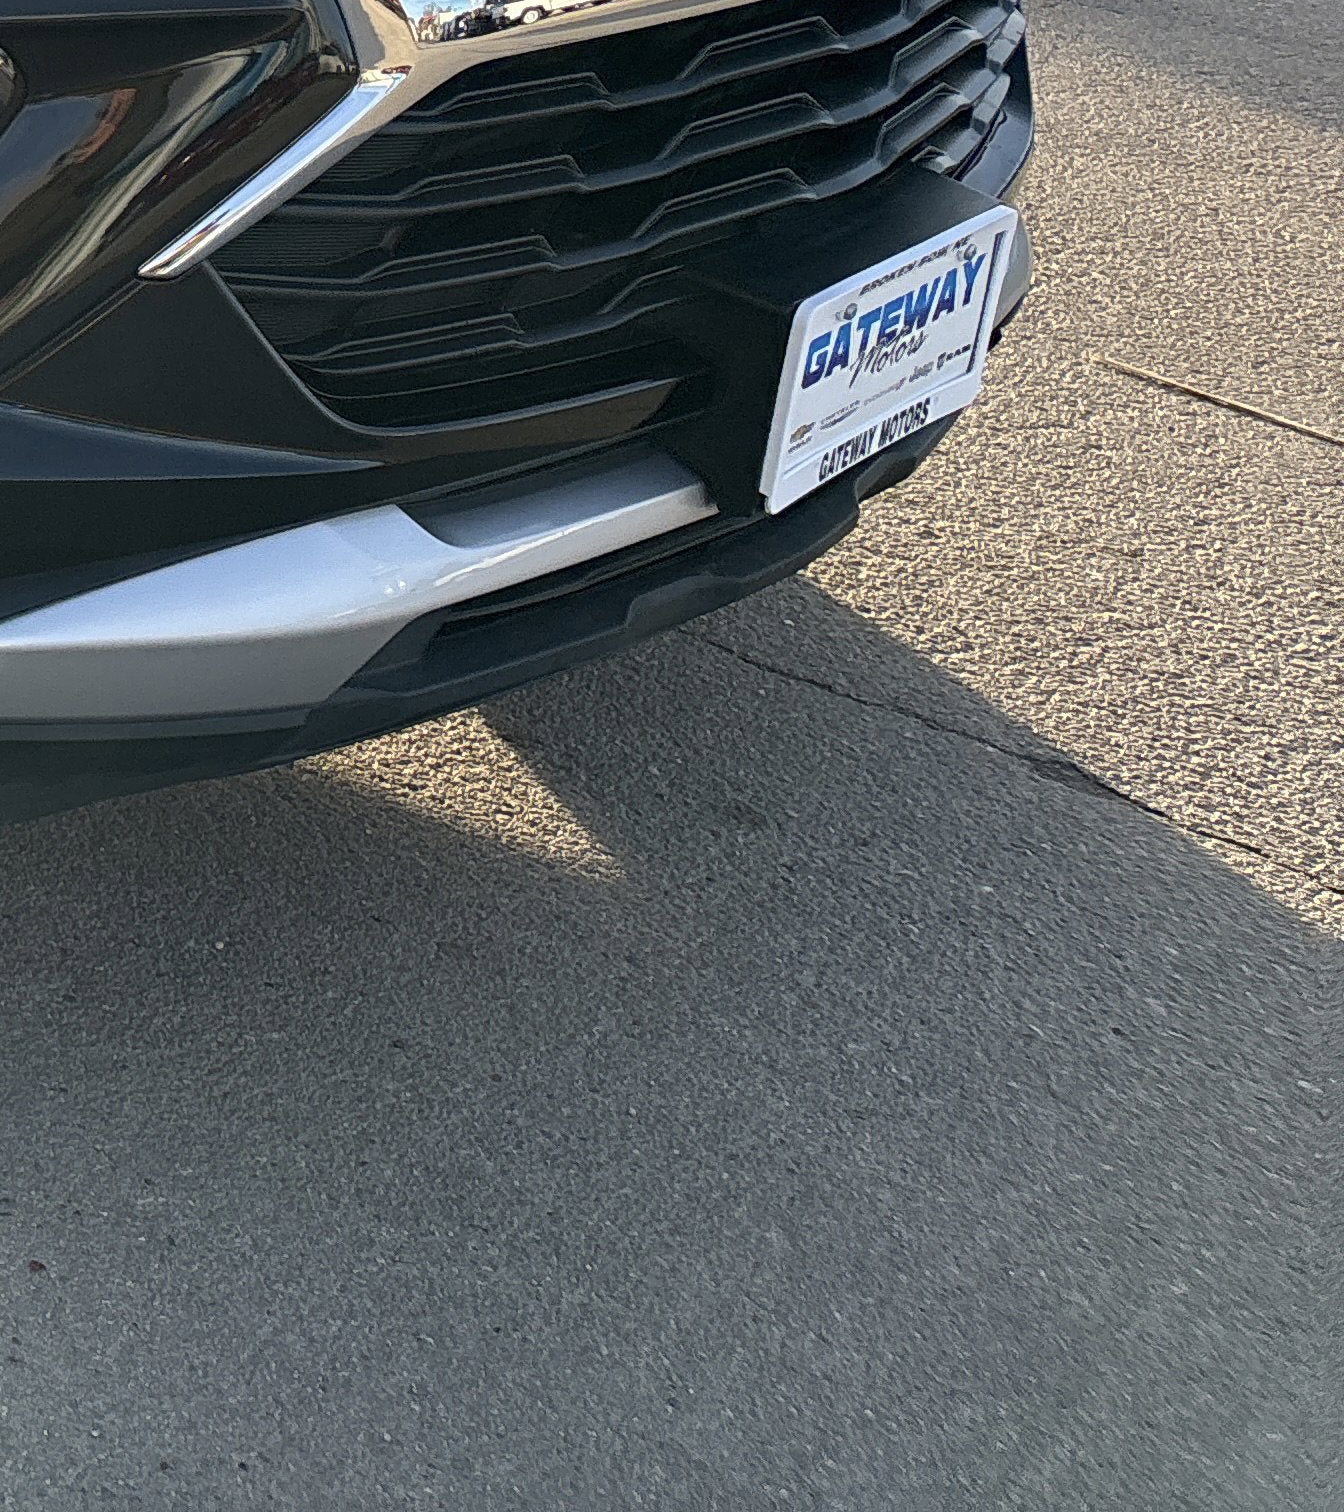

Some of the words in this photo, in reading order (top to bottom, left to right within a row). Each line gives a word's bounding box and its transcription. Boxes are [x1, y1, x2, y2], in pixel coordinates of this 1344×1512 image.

[801, 252, 987, 389] GATEWAY
[849, 325, 929, 388] Motors
[819, 425, 877, 481] GATEWAY
[878, 396, 931, 448] MOTORS
